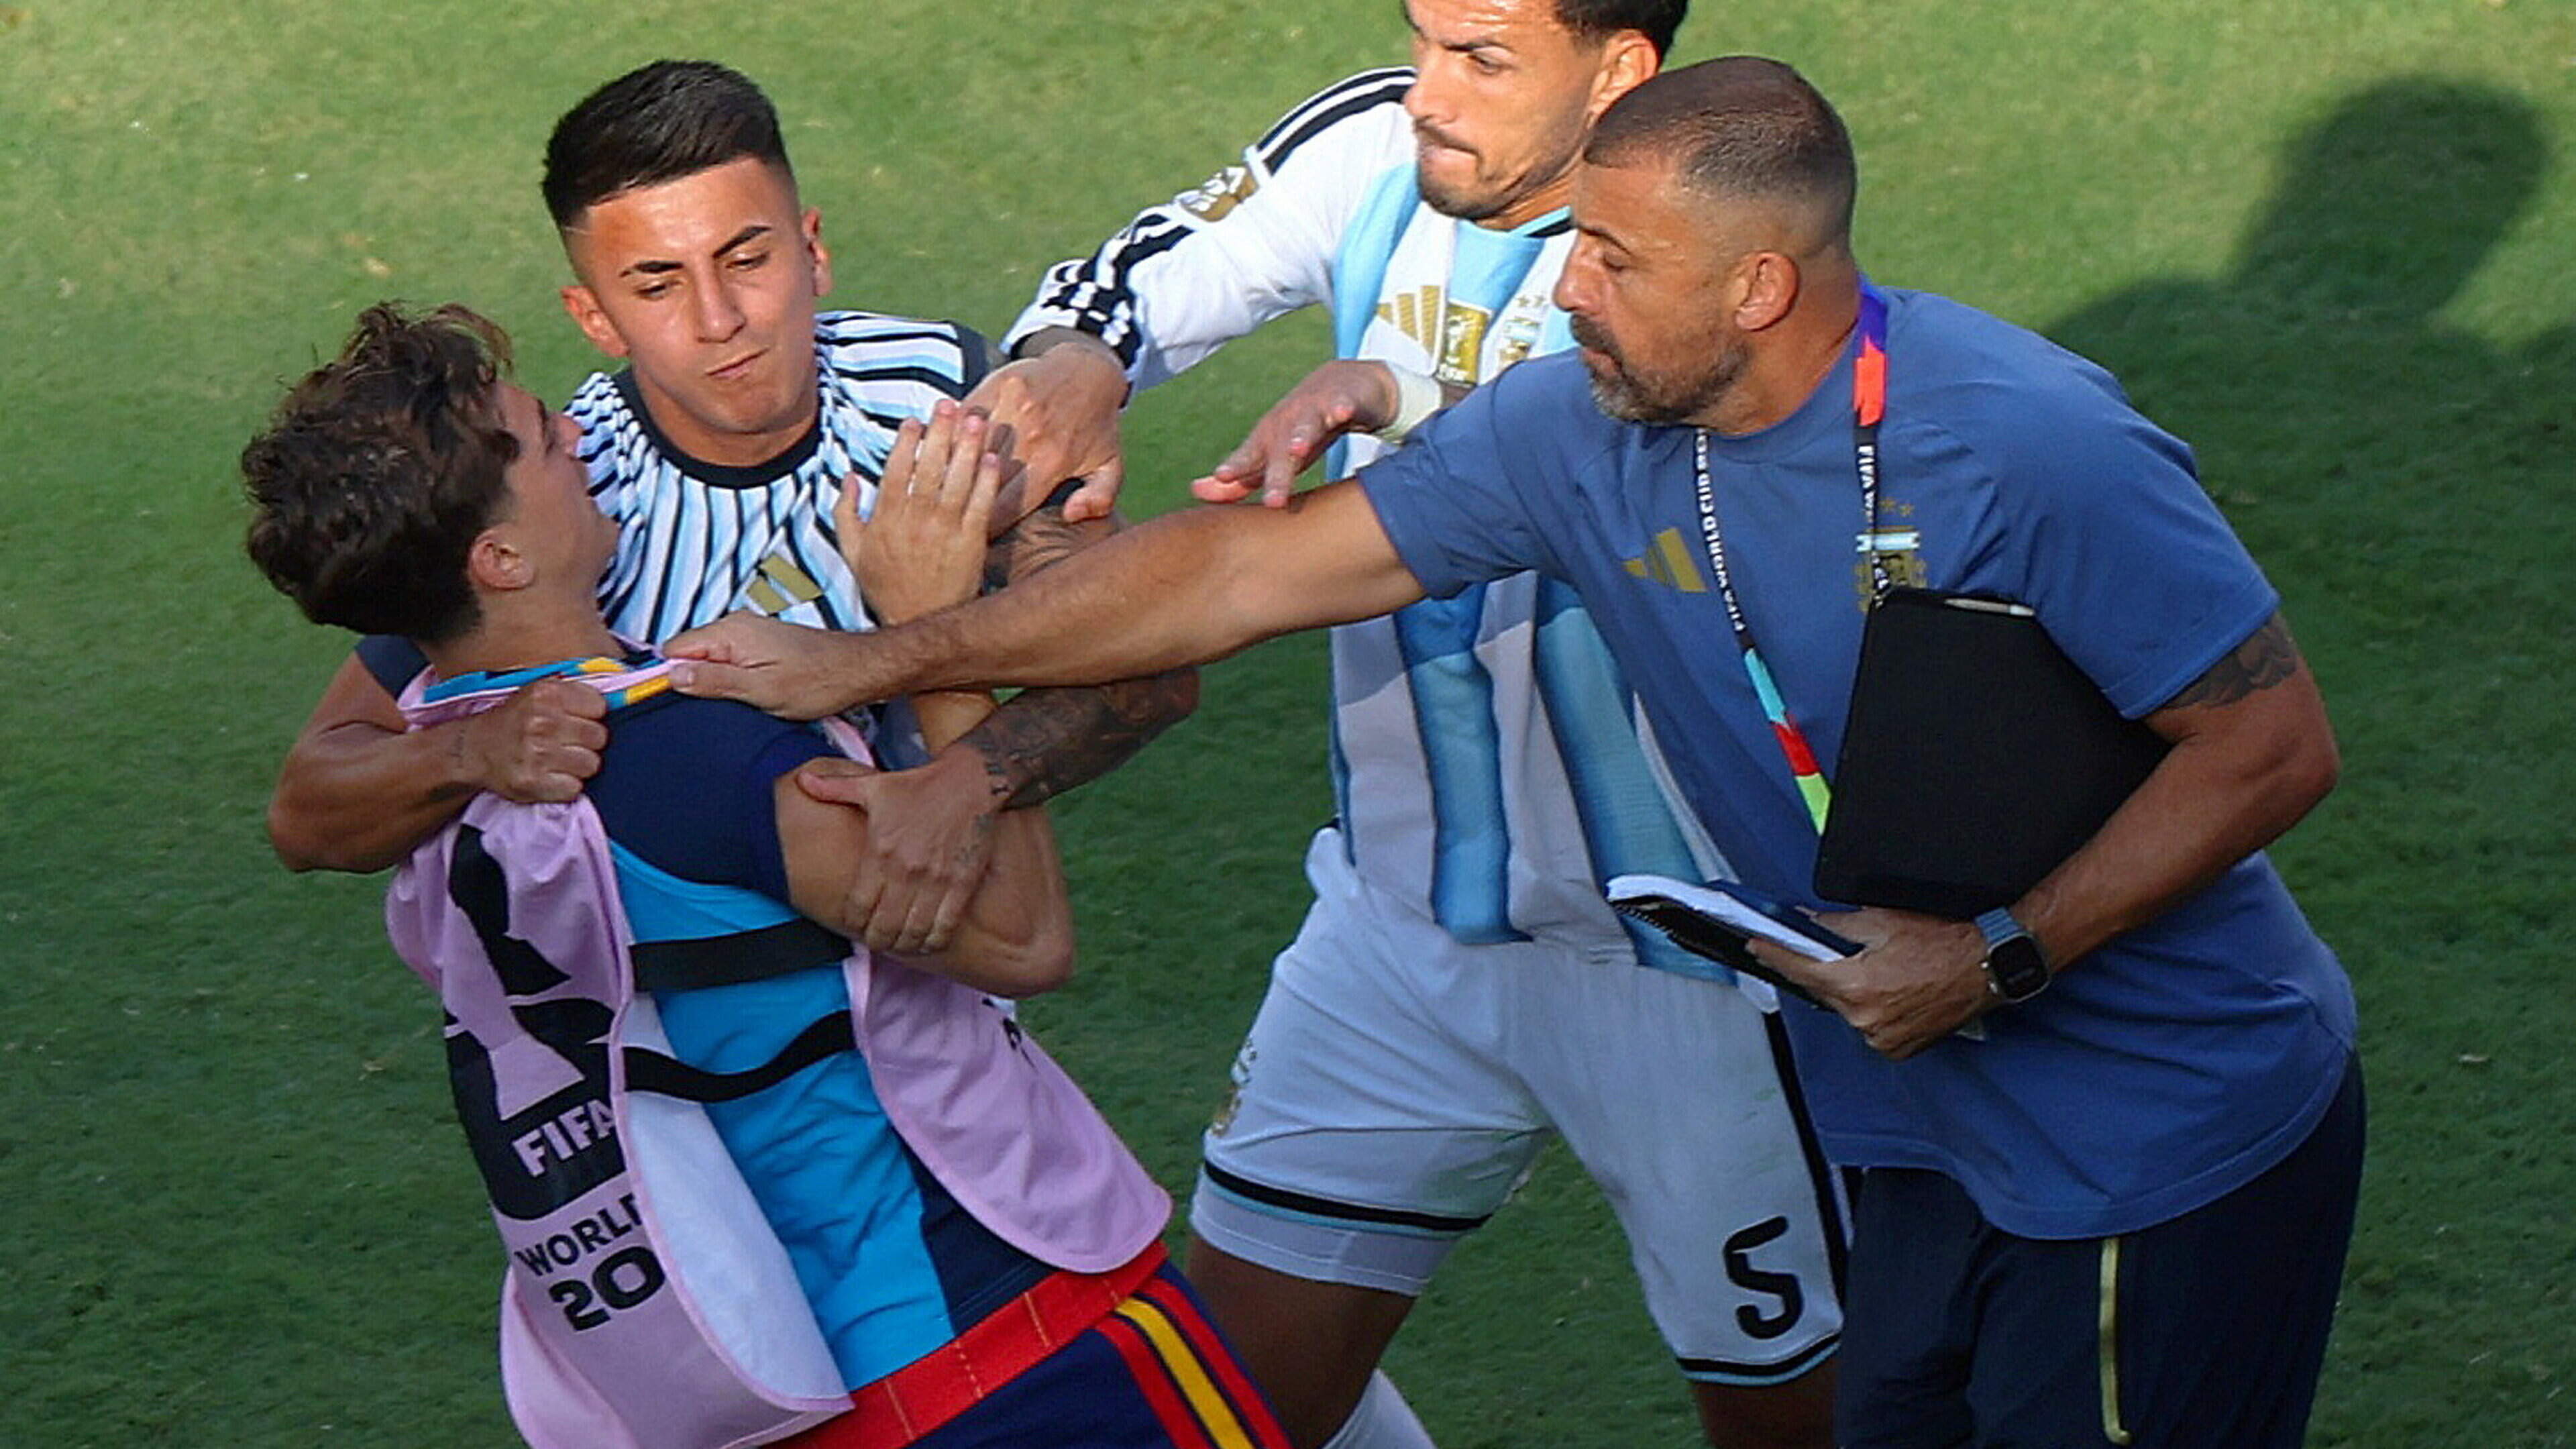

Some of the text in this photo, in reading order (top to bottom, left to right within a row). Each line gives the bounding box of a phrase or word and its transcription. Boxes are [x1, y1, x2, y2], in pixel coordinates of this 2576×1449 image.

[1858, 445, 1875, 488] FIFA
[1703, 515, 1729, 588] WORLD
[512, 1098, 616, 1177] FIFA
[1722, 1215, 1804, 1339] 5
